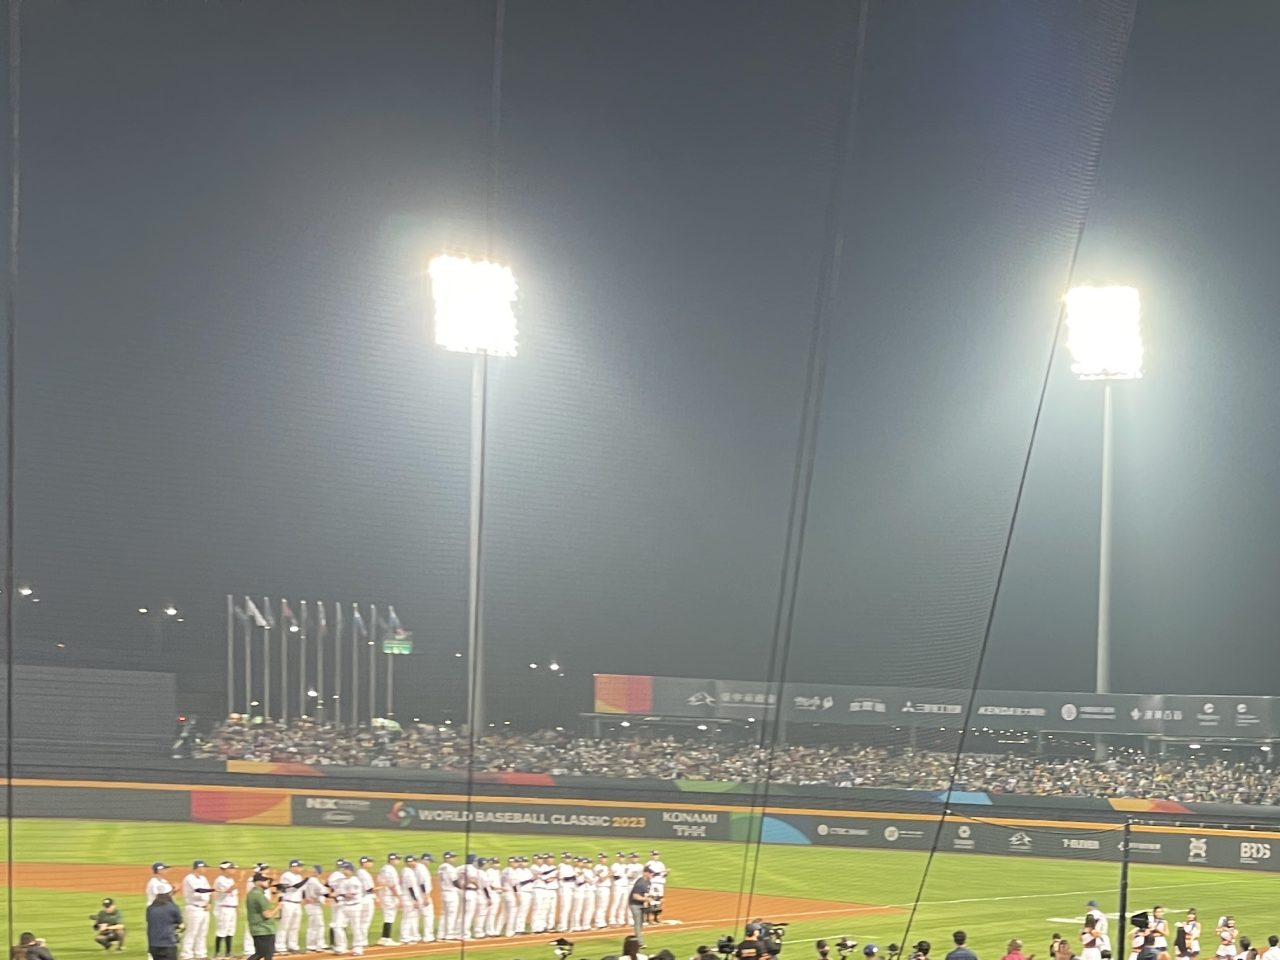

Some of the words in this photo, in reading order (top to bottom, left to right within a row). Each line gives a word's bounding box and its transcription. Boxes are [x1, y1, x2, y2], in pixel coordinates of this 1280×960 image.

[418, 809, 472, 822] WORLD
[475, 811, 549, 824] BASEBALL
[551, 814, 611, 827] CLASSIC
[611, 816, 646, 828] 2023
[662, 812, 718, 824] KONAMI
